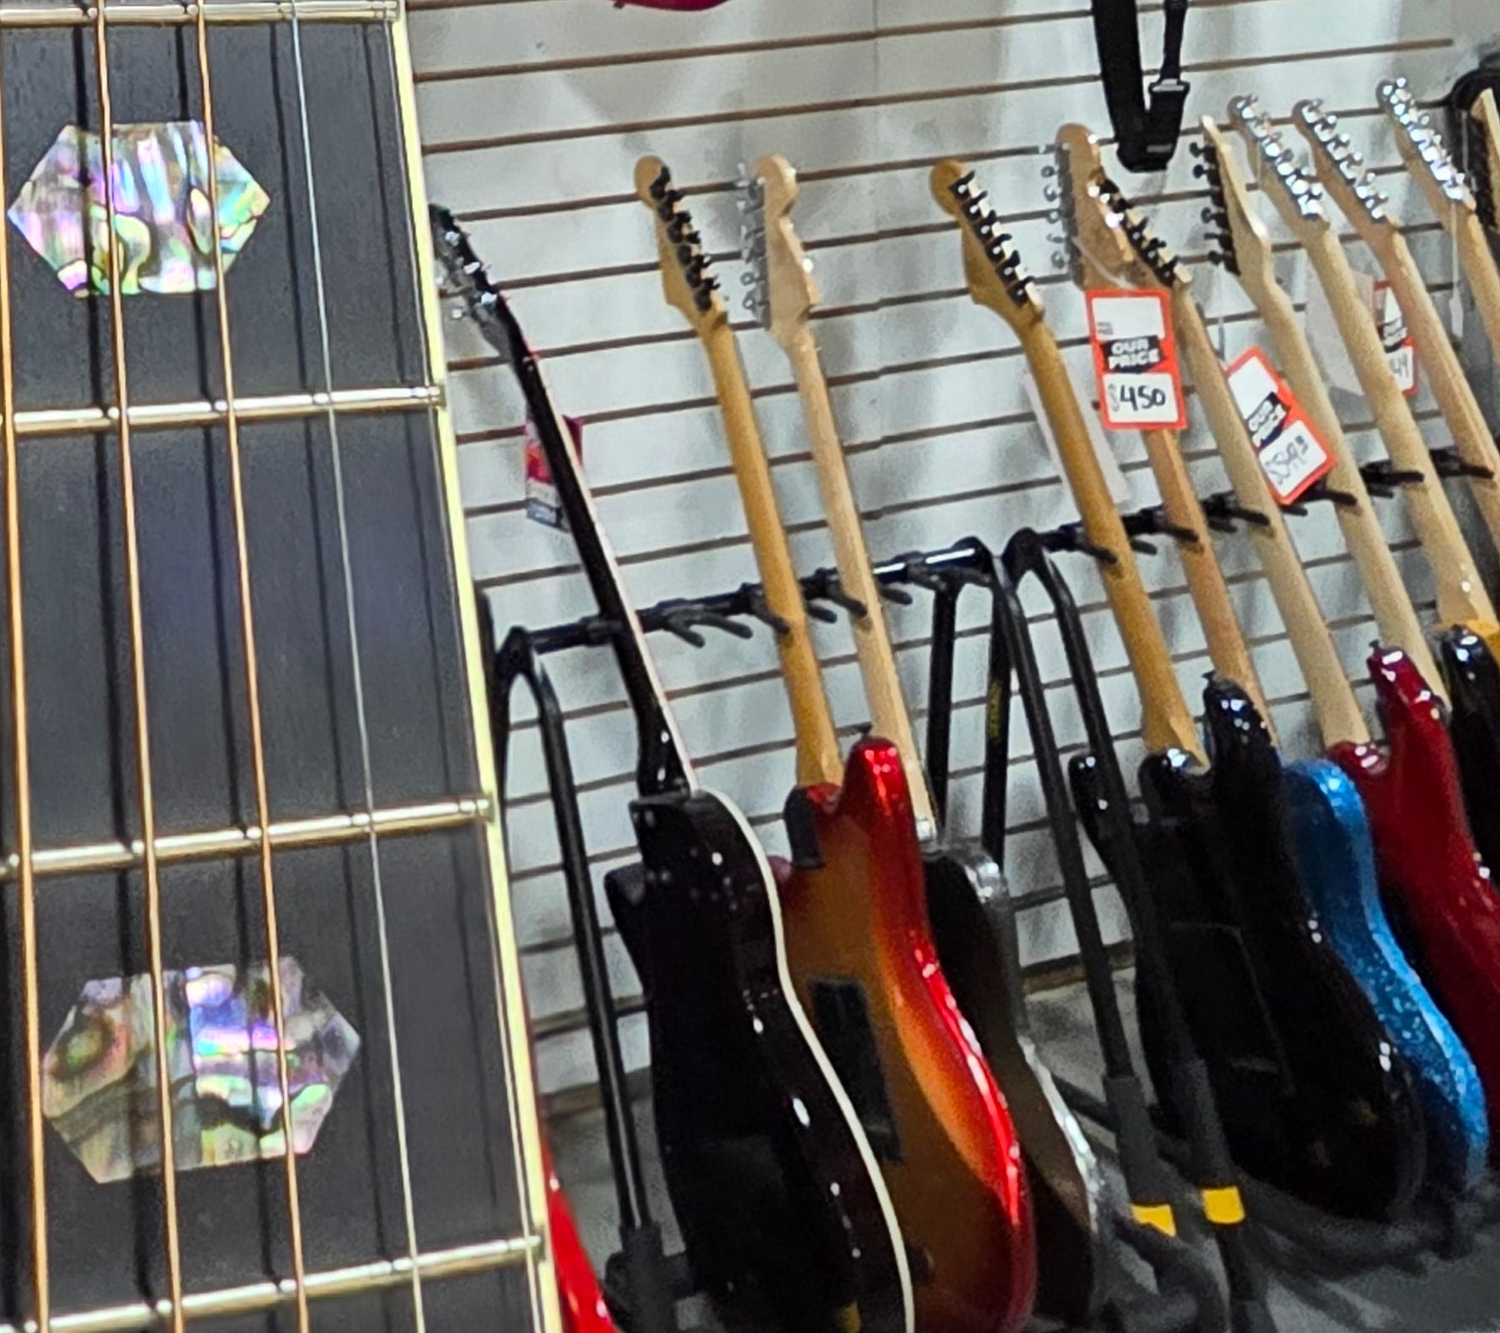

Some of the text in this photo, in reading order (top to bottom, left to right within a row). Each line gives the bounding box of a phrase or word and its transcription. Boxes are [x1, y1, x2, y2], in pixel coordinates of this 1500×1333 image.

[1111, 337, 1150, 355] OUR
[1108, 348, 1160, 370] PRICE
[1108, 383, 1167, 413] $450
